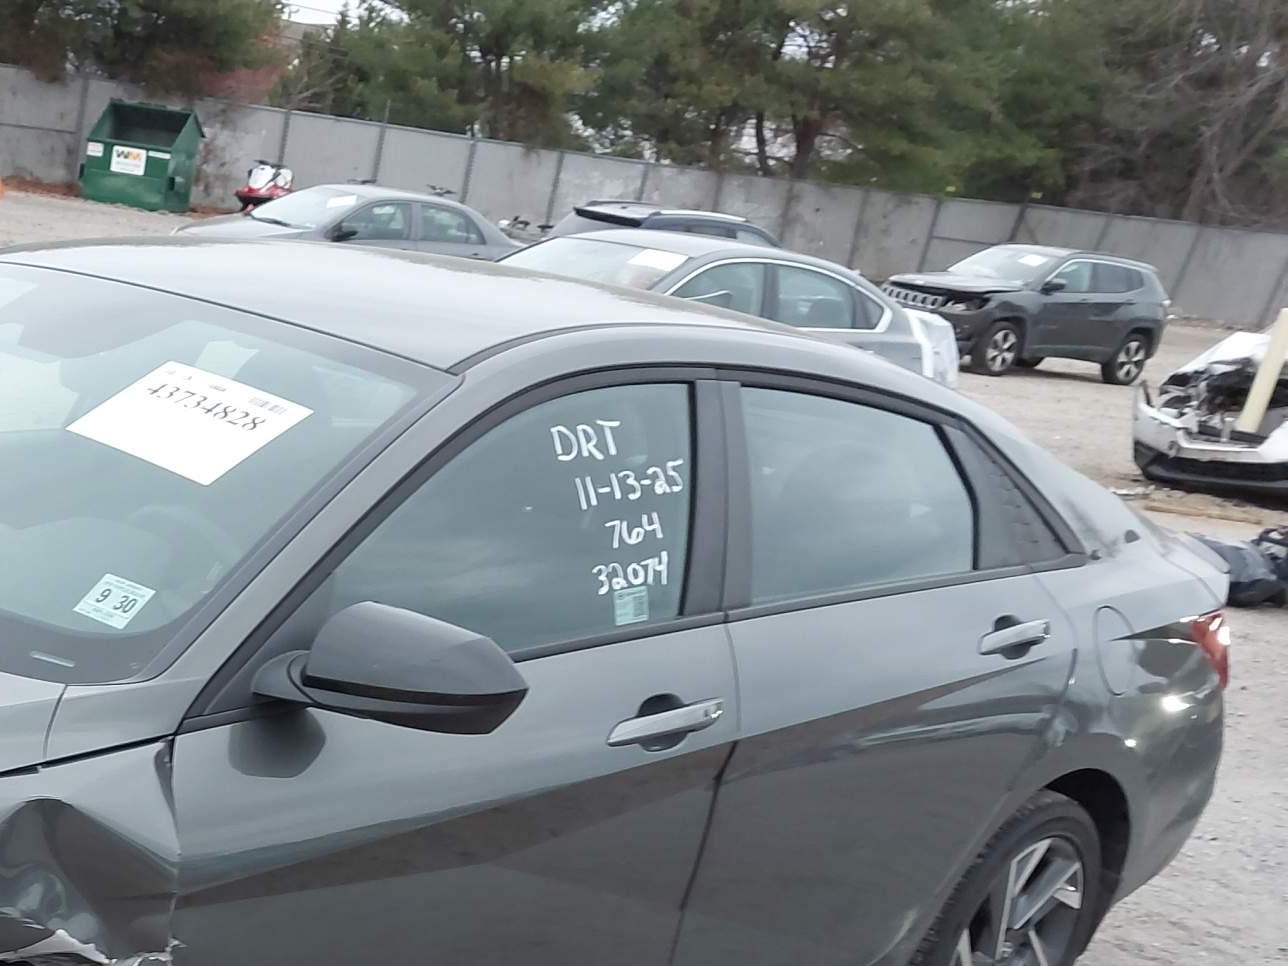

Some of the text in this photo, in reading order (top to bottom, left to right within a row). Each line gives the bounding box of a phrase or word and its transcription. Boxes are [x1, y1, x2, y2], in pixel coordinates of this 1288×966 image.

[146, 383, 266, 432] 43734828
[550, 419, 621, 461] DRT
[574, 458, 684, 510] 11-13-25
[604, 511, 664, 549] 764
[591, 550, 669, 595] 32074
[95, 588, 138, 613] 9 30
